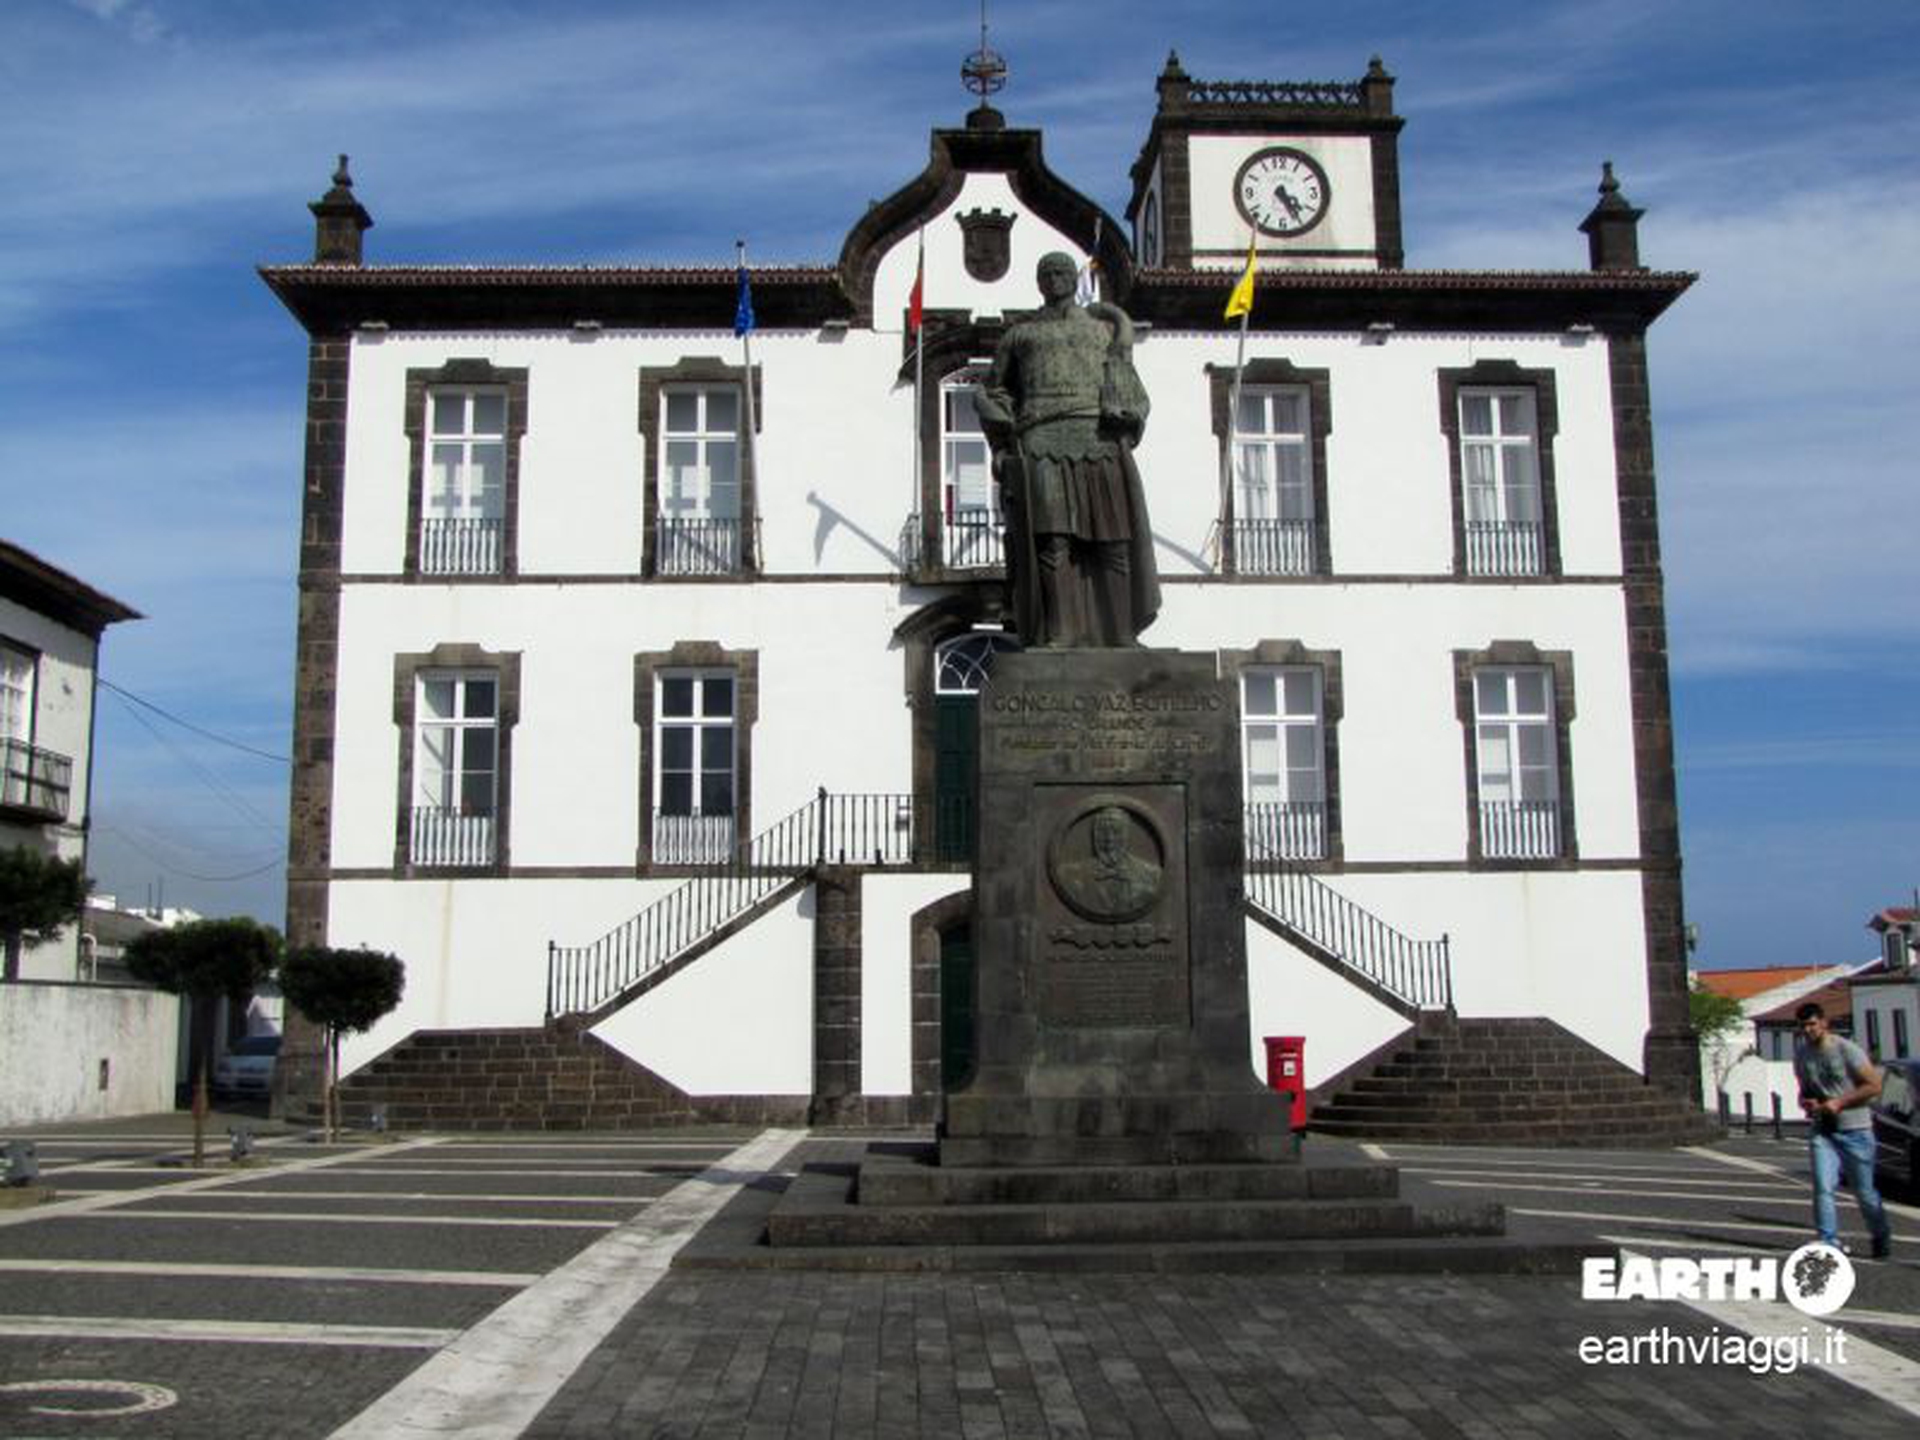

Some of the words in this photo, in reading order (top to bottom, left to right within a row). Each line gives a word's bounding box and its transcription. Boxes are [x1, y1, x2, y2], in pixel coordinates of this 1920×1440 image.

[1272, 157, 1287, 169] 12
[1245, 187, 1255, 200] 9
[1309, 186, 1319, 200] 3
